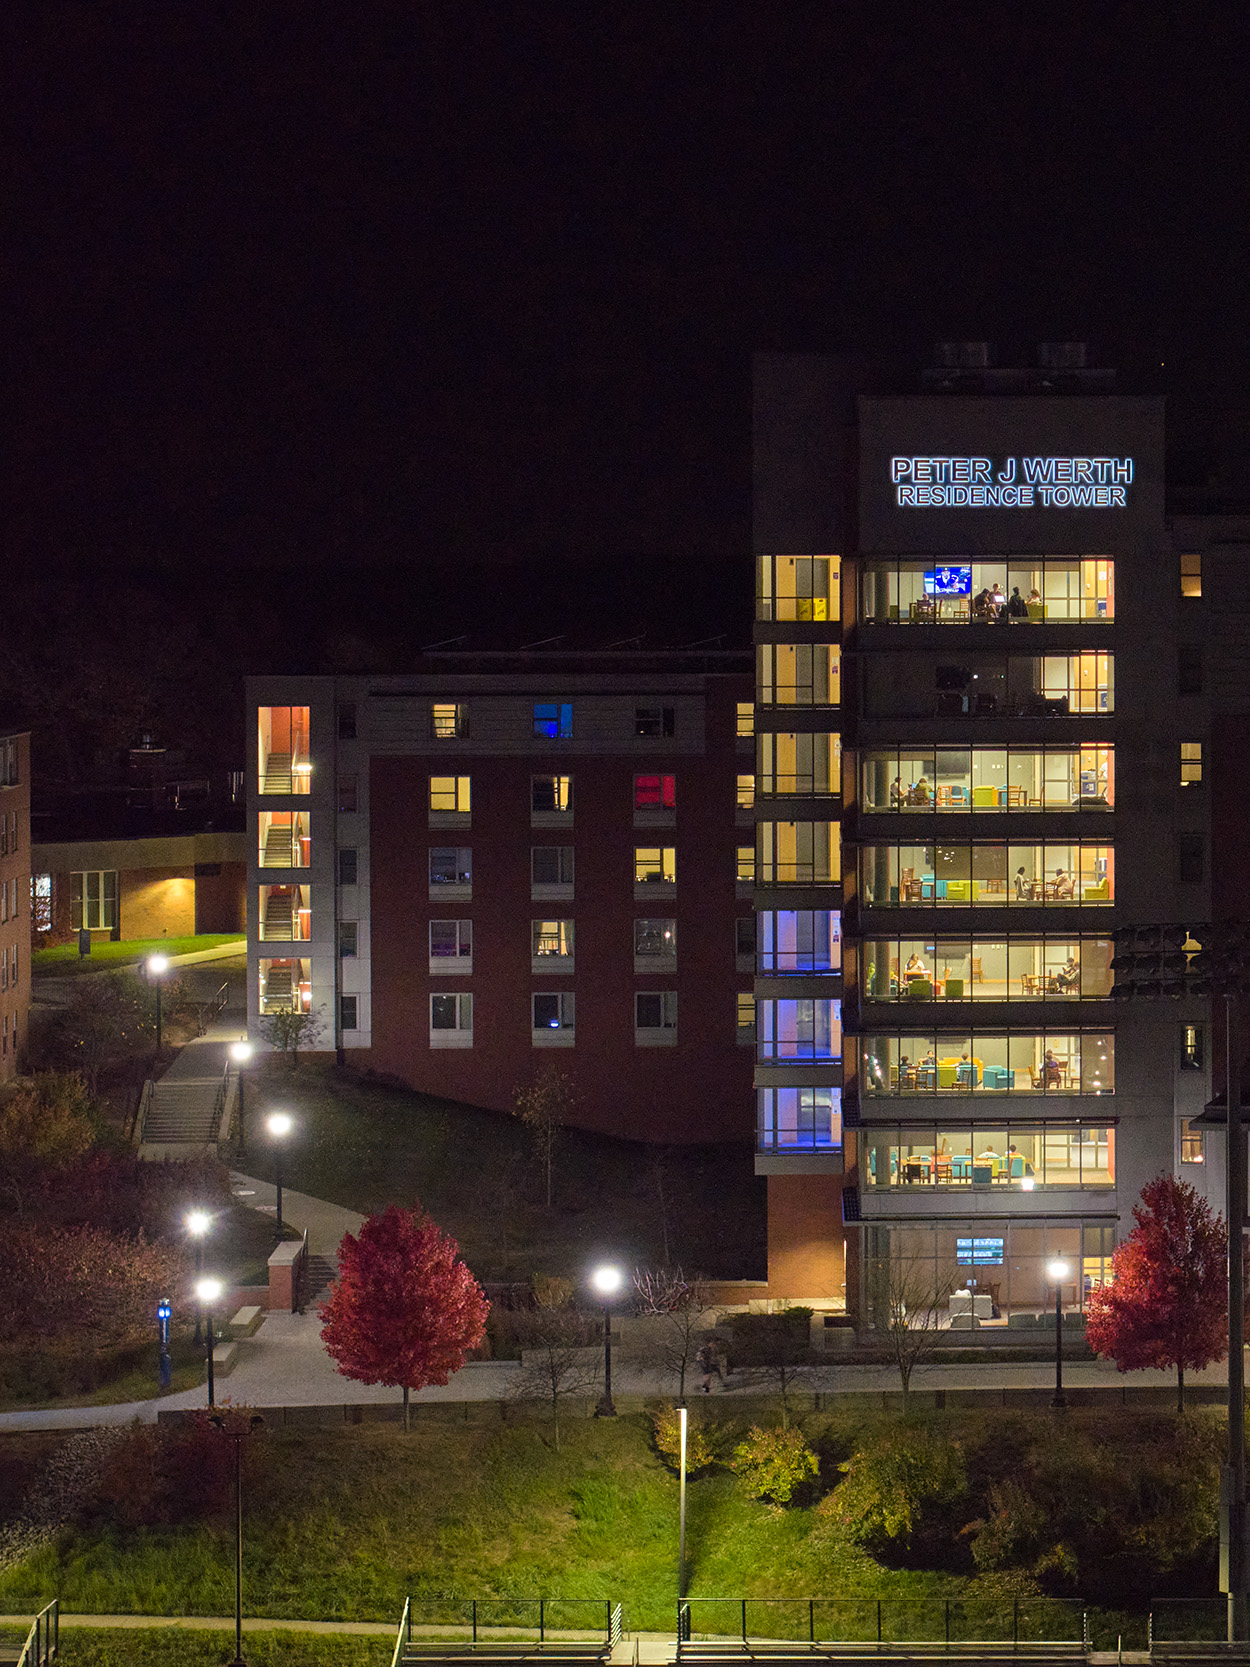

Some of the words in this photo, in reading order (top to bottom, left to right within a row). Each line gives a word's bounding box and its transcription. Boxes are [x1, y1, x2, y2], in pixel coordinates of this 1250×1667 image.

[892, 458, 991, 483] PETER
[999, 458, 1016, 483] J
[1024, 458, 1133, 483] WERTH
[898, 486, 1033, 506] RESIDENCE
[1039, 486, 1126, 506] TOWER
